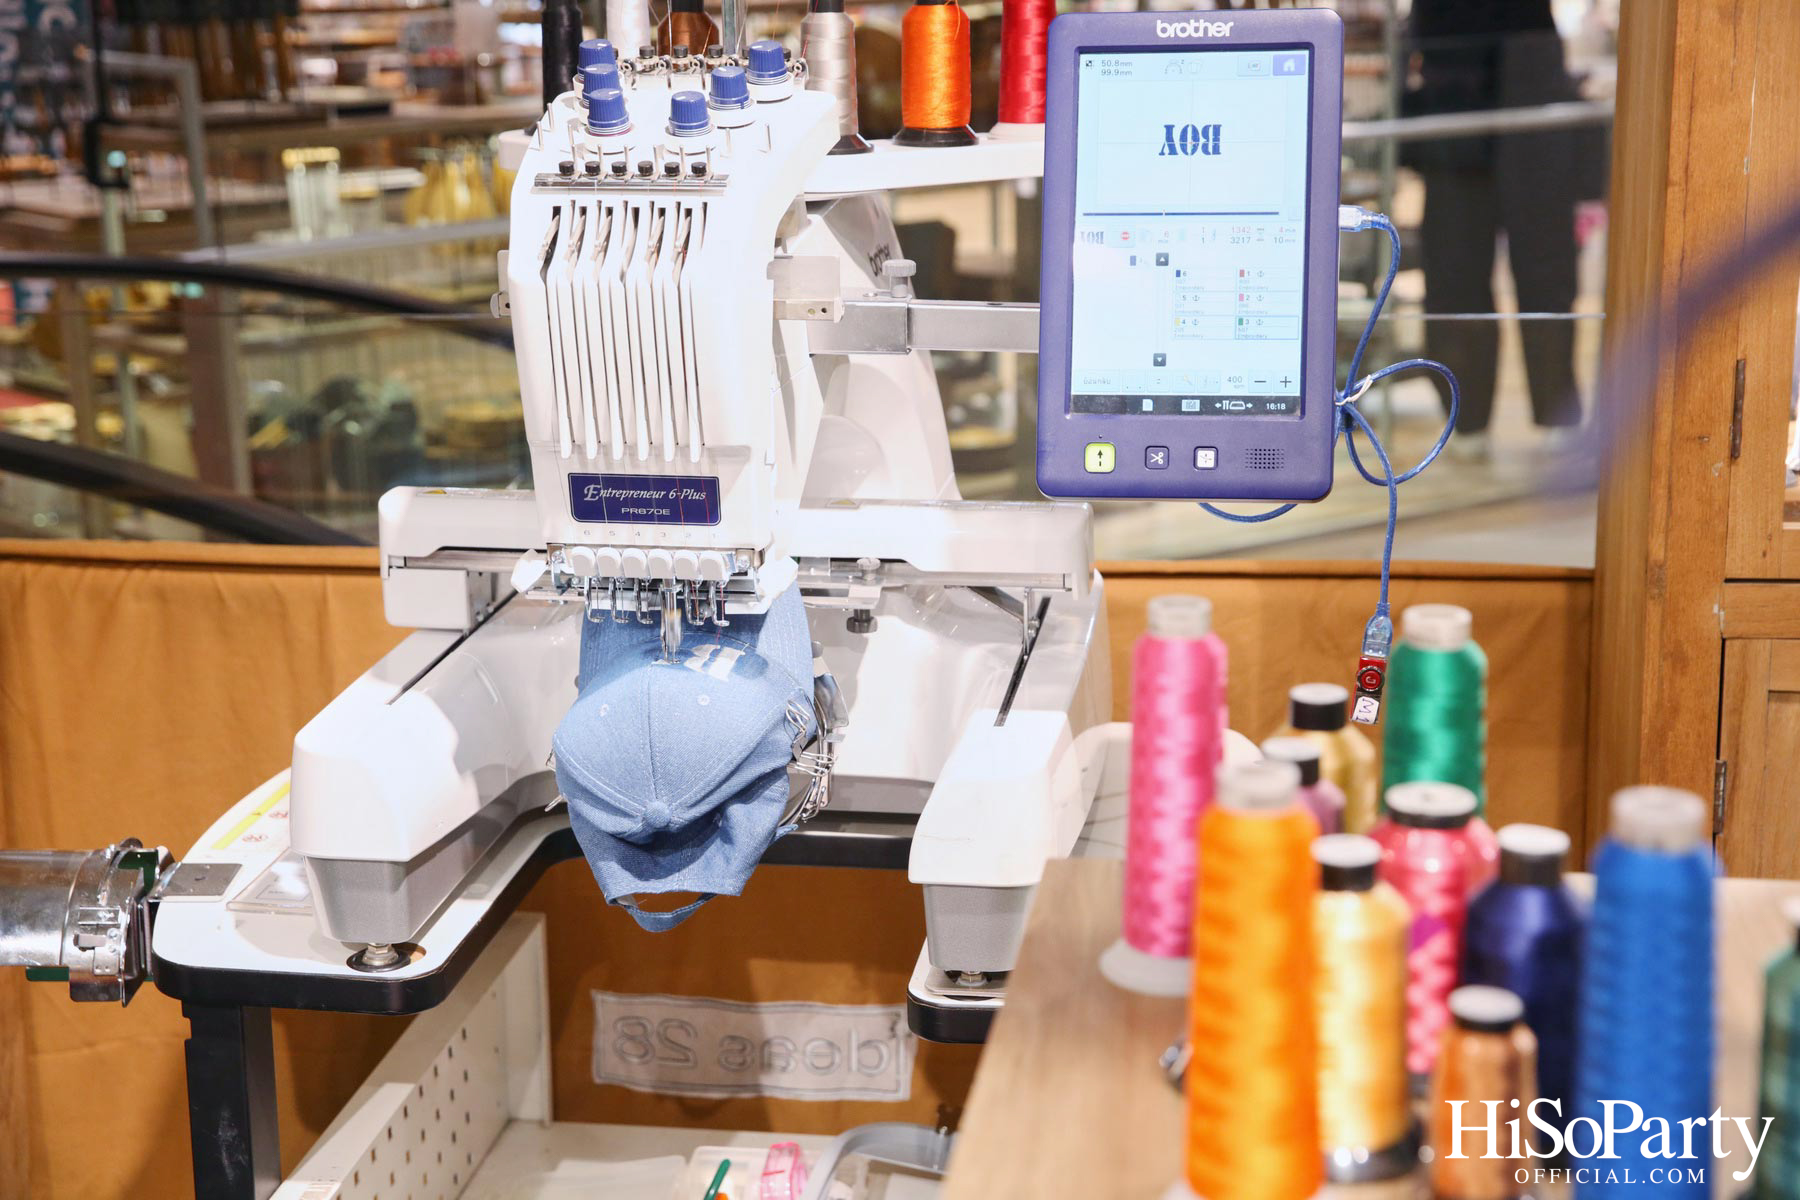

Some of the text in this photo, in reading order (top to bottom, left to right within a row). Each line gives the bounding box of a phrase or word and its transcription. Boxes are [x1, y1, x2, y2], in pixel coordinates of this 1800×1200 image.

[1156, 19, 1235, 38] brother
[1226, 376, 1243, 384] 400
[1266, 402, 1286, 410] 16:18
[583, 484, 707, 501] Entrepreneur 6-Plus
[621, 507, 671, 516] PR670E
